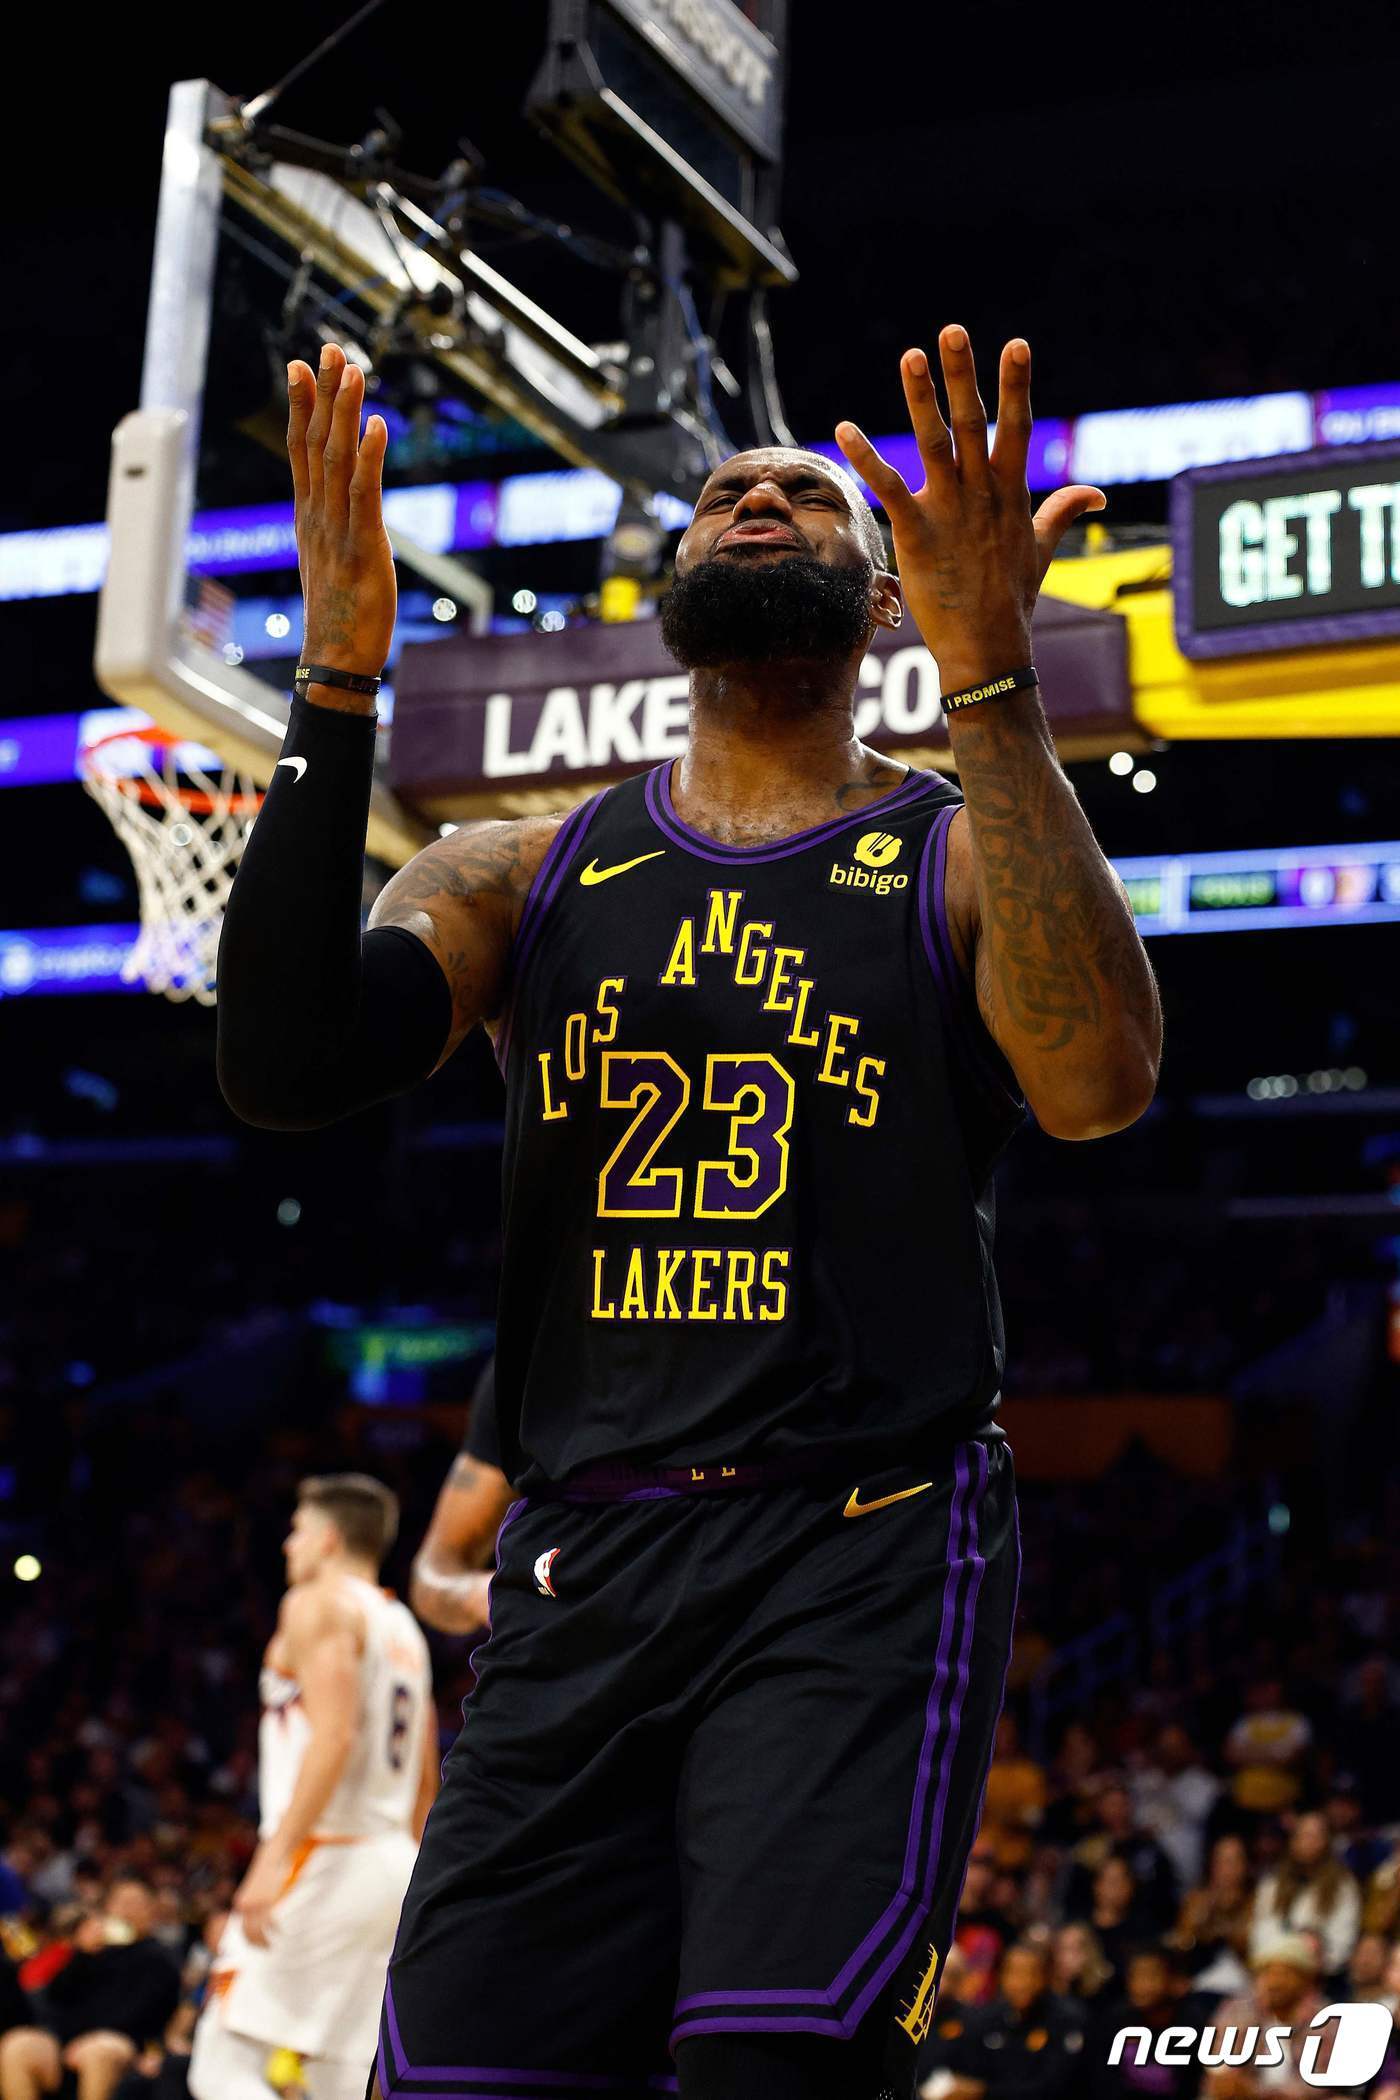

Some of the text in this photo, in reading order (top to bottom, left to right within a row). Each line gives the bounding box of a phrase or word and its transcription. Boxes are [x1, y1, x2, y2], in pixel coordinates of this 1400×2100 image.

[1219, 481, 1400, 608] GET T
[483, 674, 690, 778] LAKE
[946, 677, 1016, 710] I PROMISE
[829, 863, 909, 895] bibigo
[537, 976, 627, 1122] LOS
[660, 889, 887, 1128] ANGELES
[596, 1051, 796, 1220] 23
[590, 1247, 791, 1322] LAKERS
